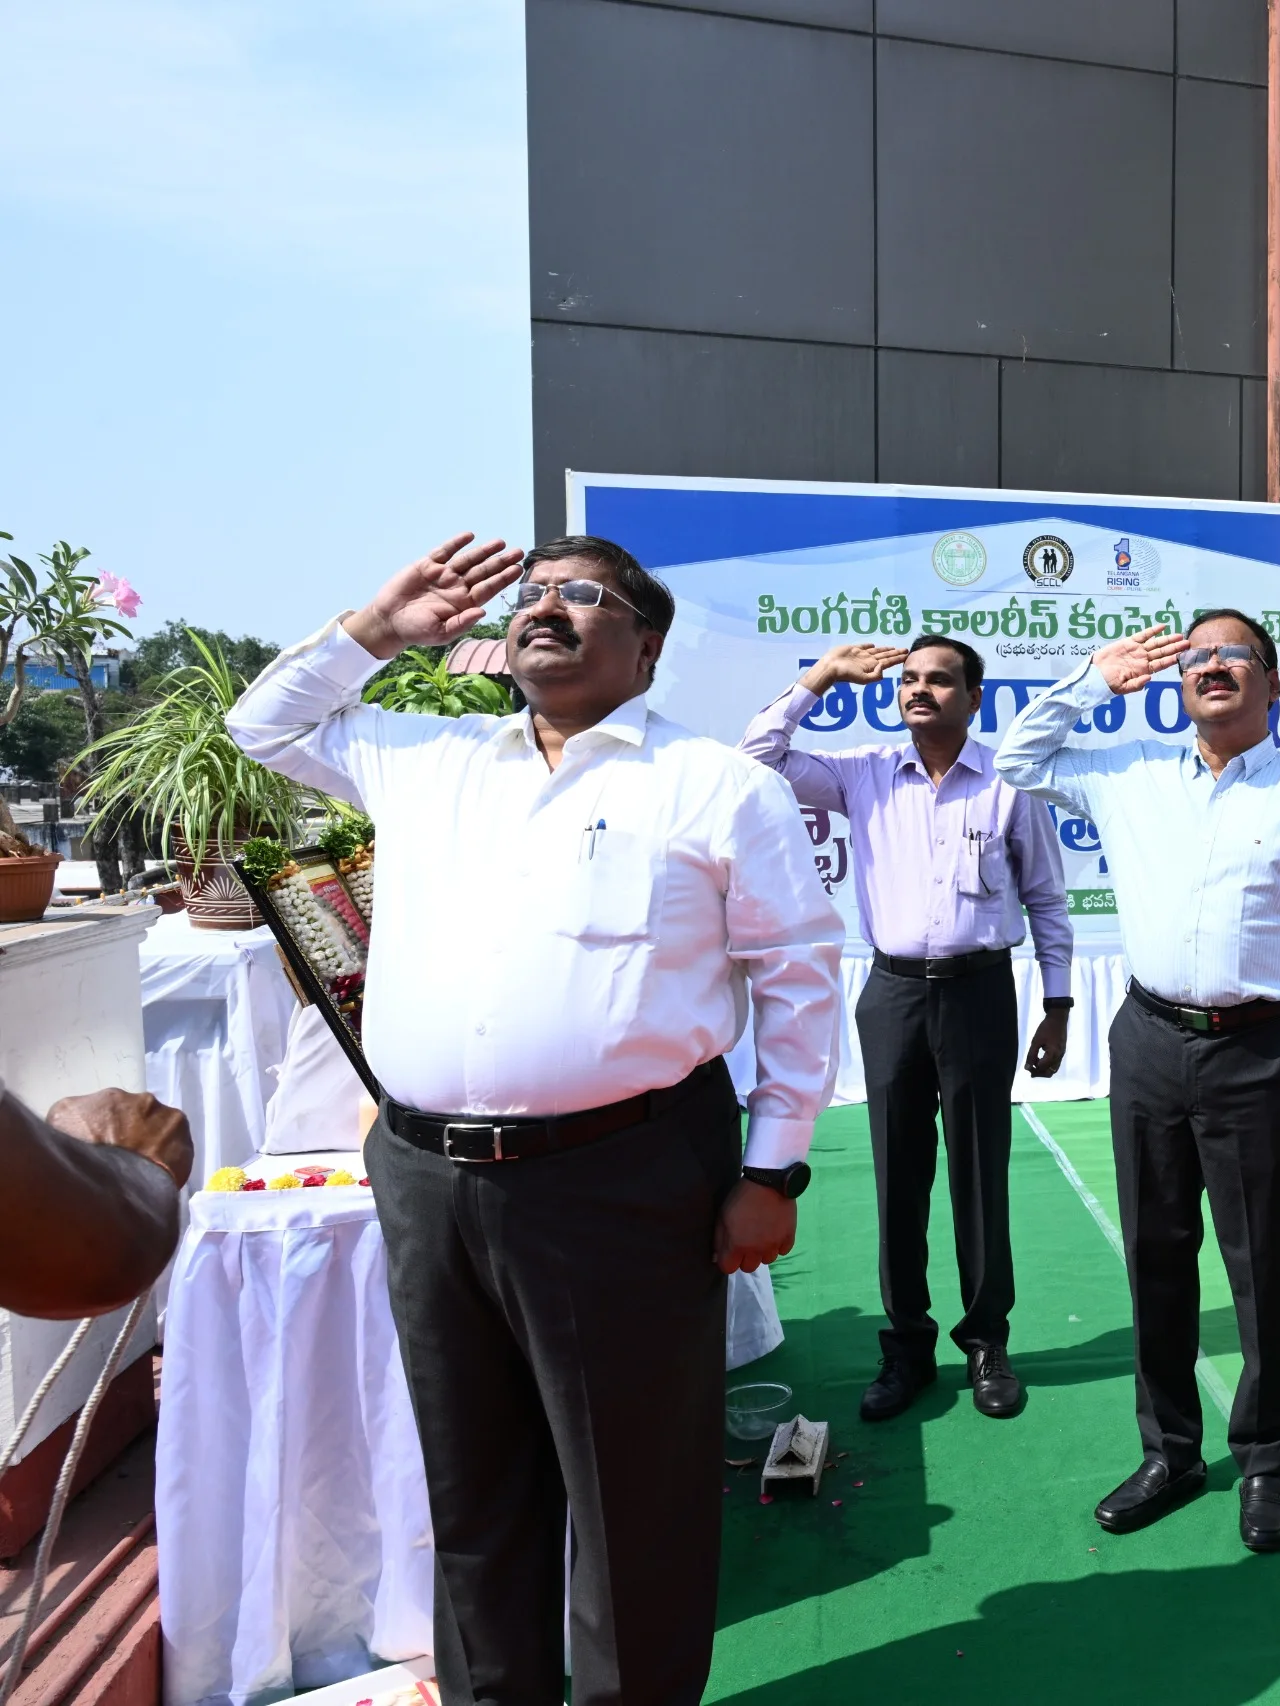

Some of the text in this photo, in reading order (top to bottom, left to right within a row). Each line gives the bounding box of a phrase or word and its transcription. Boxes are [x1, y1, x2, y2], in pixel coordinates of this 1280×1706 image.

[1036, 577, 1062, 587] SCCL
[1106, 577, 1140, 587] RISING
[757, 586, 912, 636] సింగరేణి
[921, 595, 1059, 639] కాలరీస్
